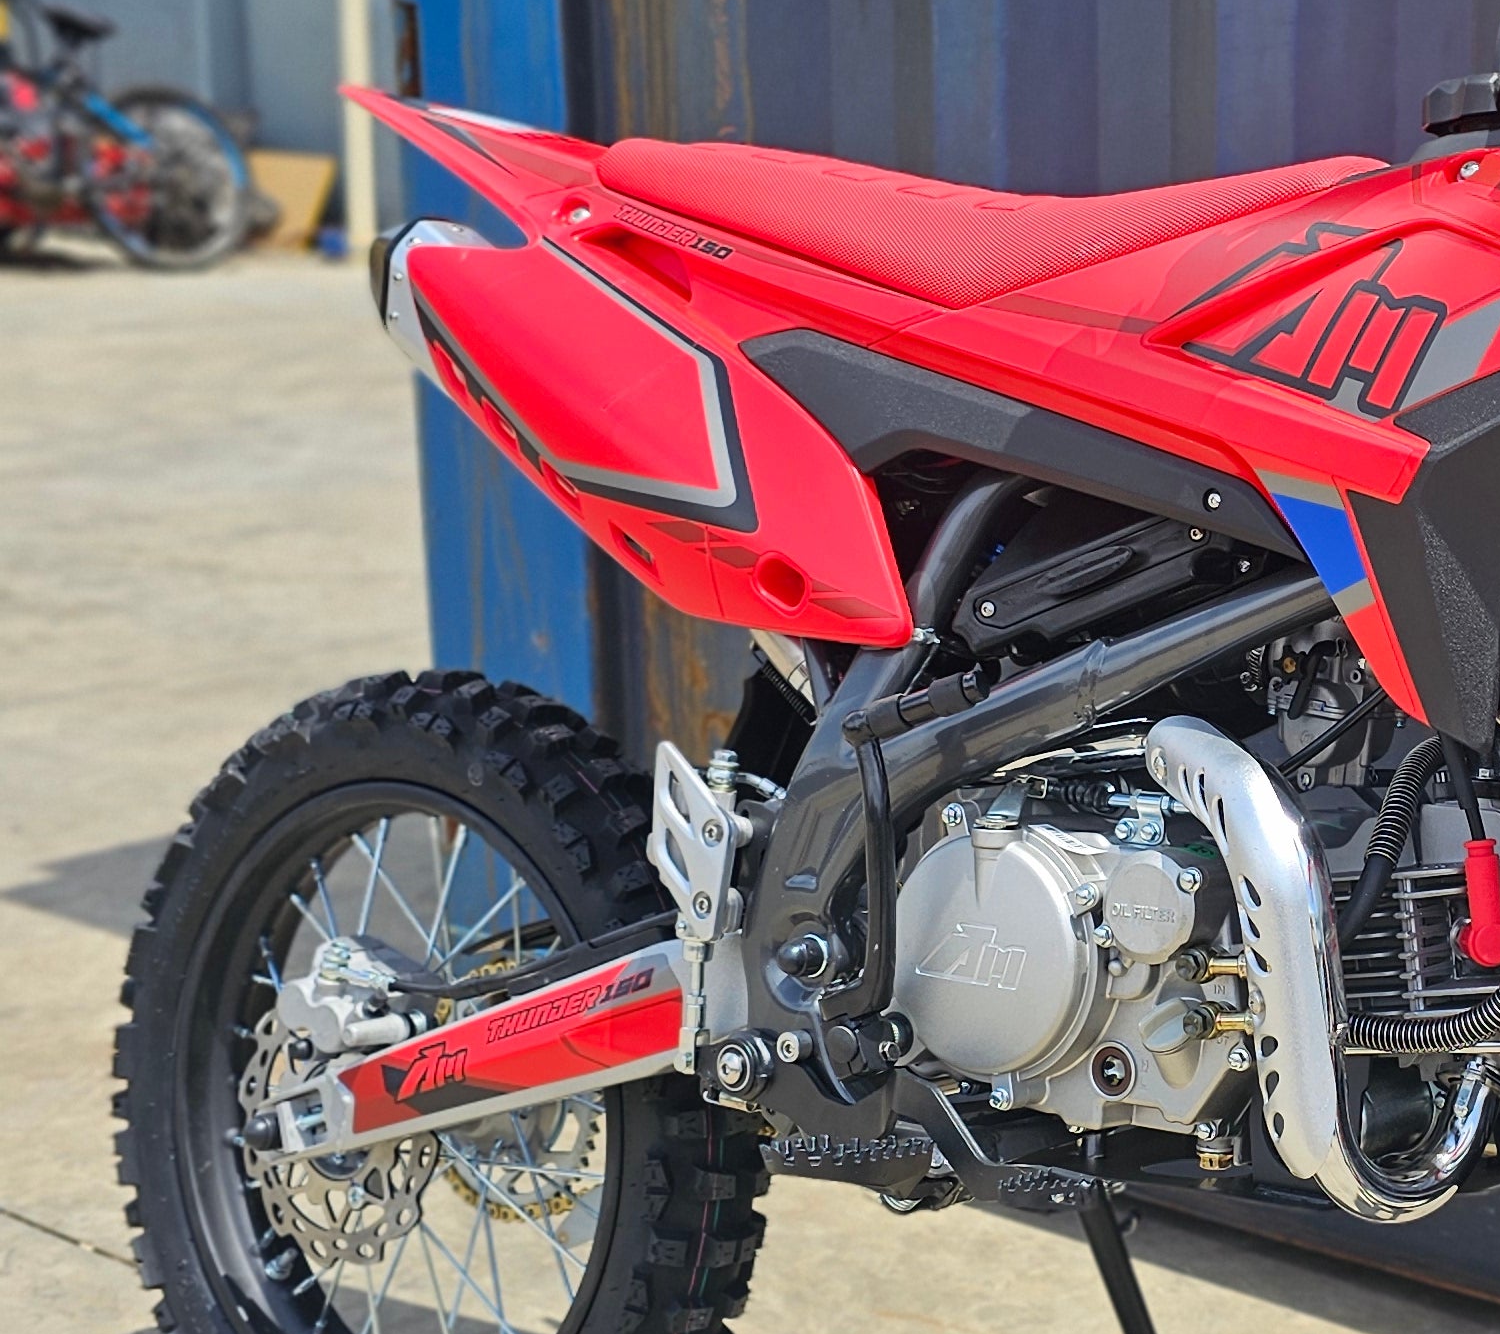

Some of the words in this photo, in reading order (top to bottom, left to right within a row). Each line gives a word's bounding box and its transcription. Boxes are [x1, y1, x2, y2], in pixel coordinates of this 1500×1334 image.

[613, 203, 698, 247] THUNDER
[690, 236, 734, 260] 150
[1111, 902, 1132, 917] OIL
[1132, 904, 1176, 923] FILTER
[486, 984, 602, 1044] THUNDER
